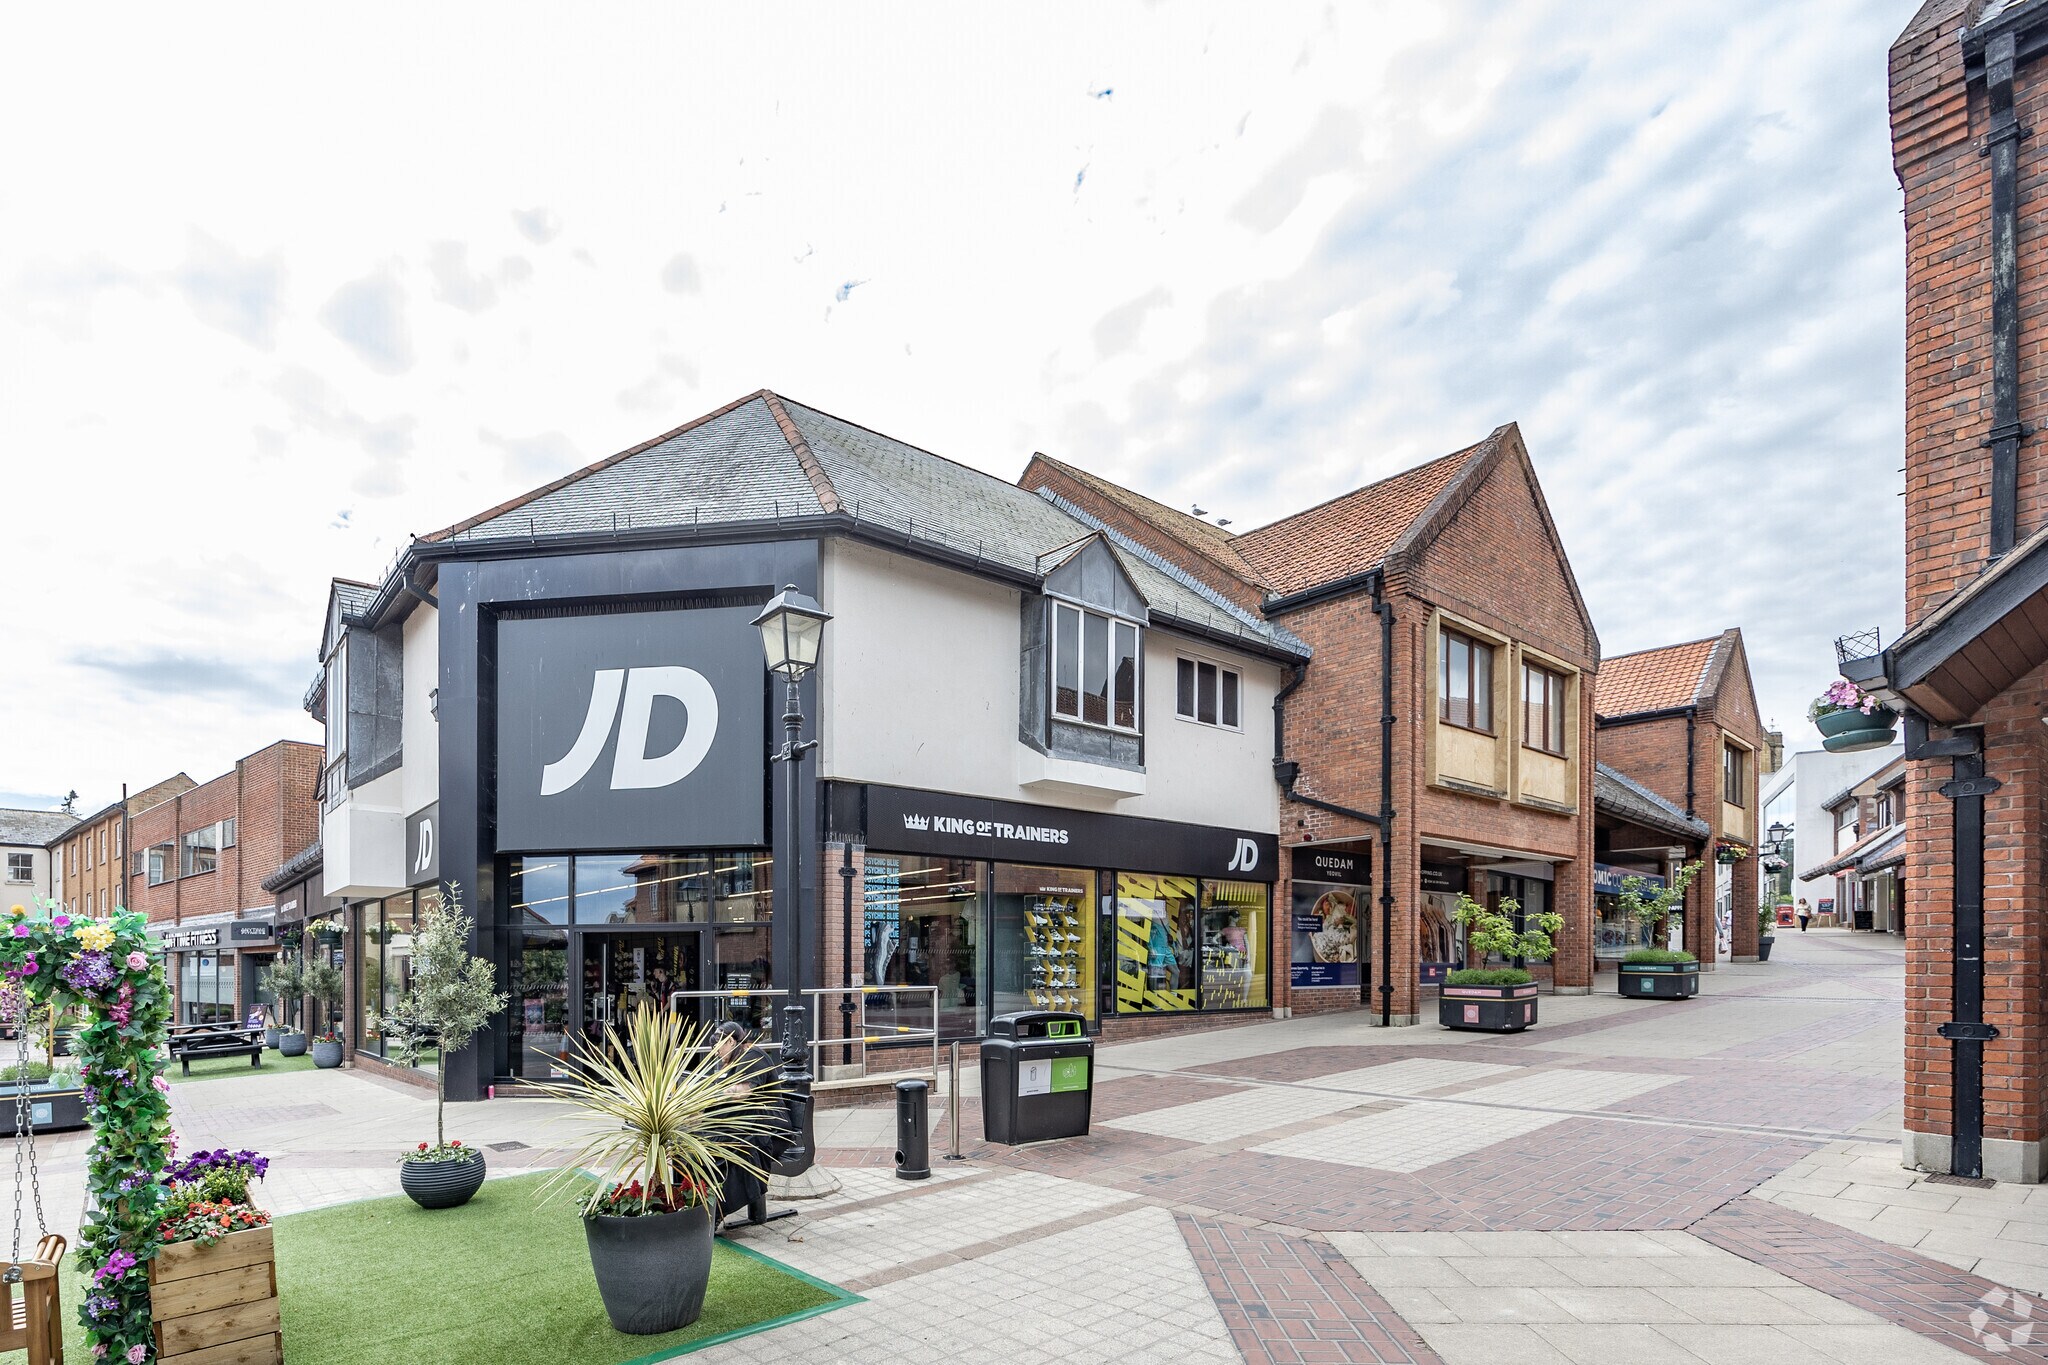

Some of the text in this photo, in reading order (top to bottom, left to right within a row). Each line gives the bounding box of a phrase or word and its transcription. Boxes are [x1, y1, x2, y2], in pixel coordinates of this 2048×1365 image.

[540, 665, 719, 796] JD
[933, 815, 1069, 845] KING OF TRAINERS
[414, 818, 433, 875] JD
[1227, 837, 1259, 872] JD
[886, 858, 900, 867] BLUE
[1315, 855, 1354, 870] QUEDAM
[864, 866, 900, 876] PSYCHIC BLUE
[1594, 869, 1612, 886] OMIC
[886, 885, 900, 894] BLUE
[886, 894, 900, 903] BLUE
[886, 903, 900, 911] BLUE
[864, 911, 900, 920] PSYCHIC BLUE
